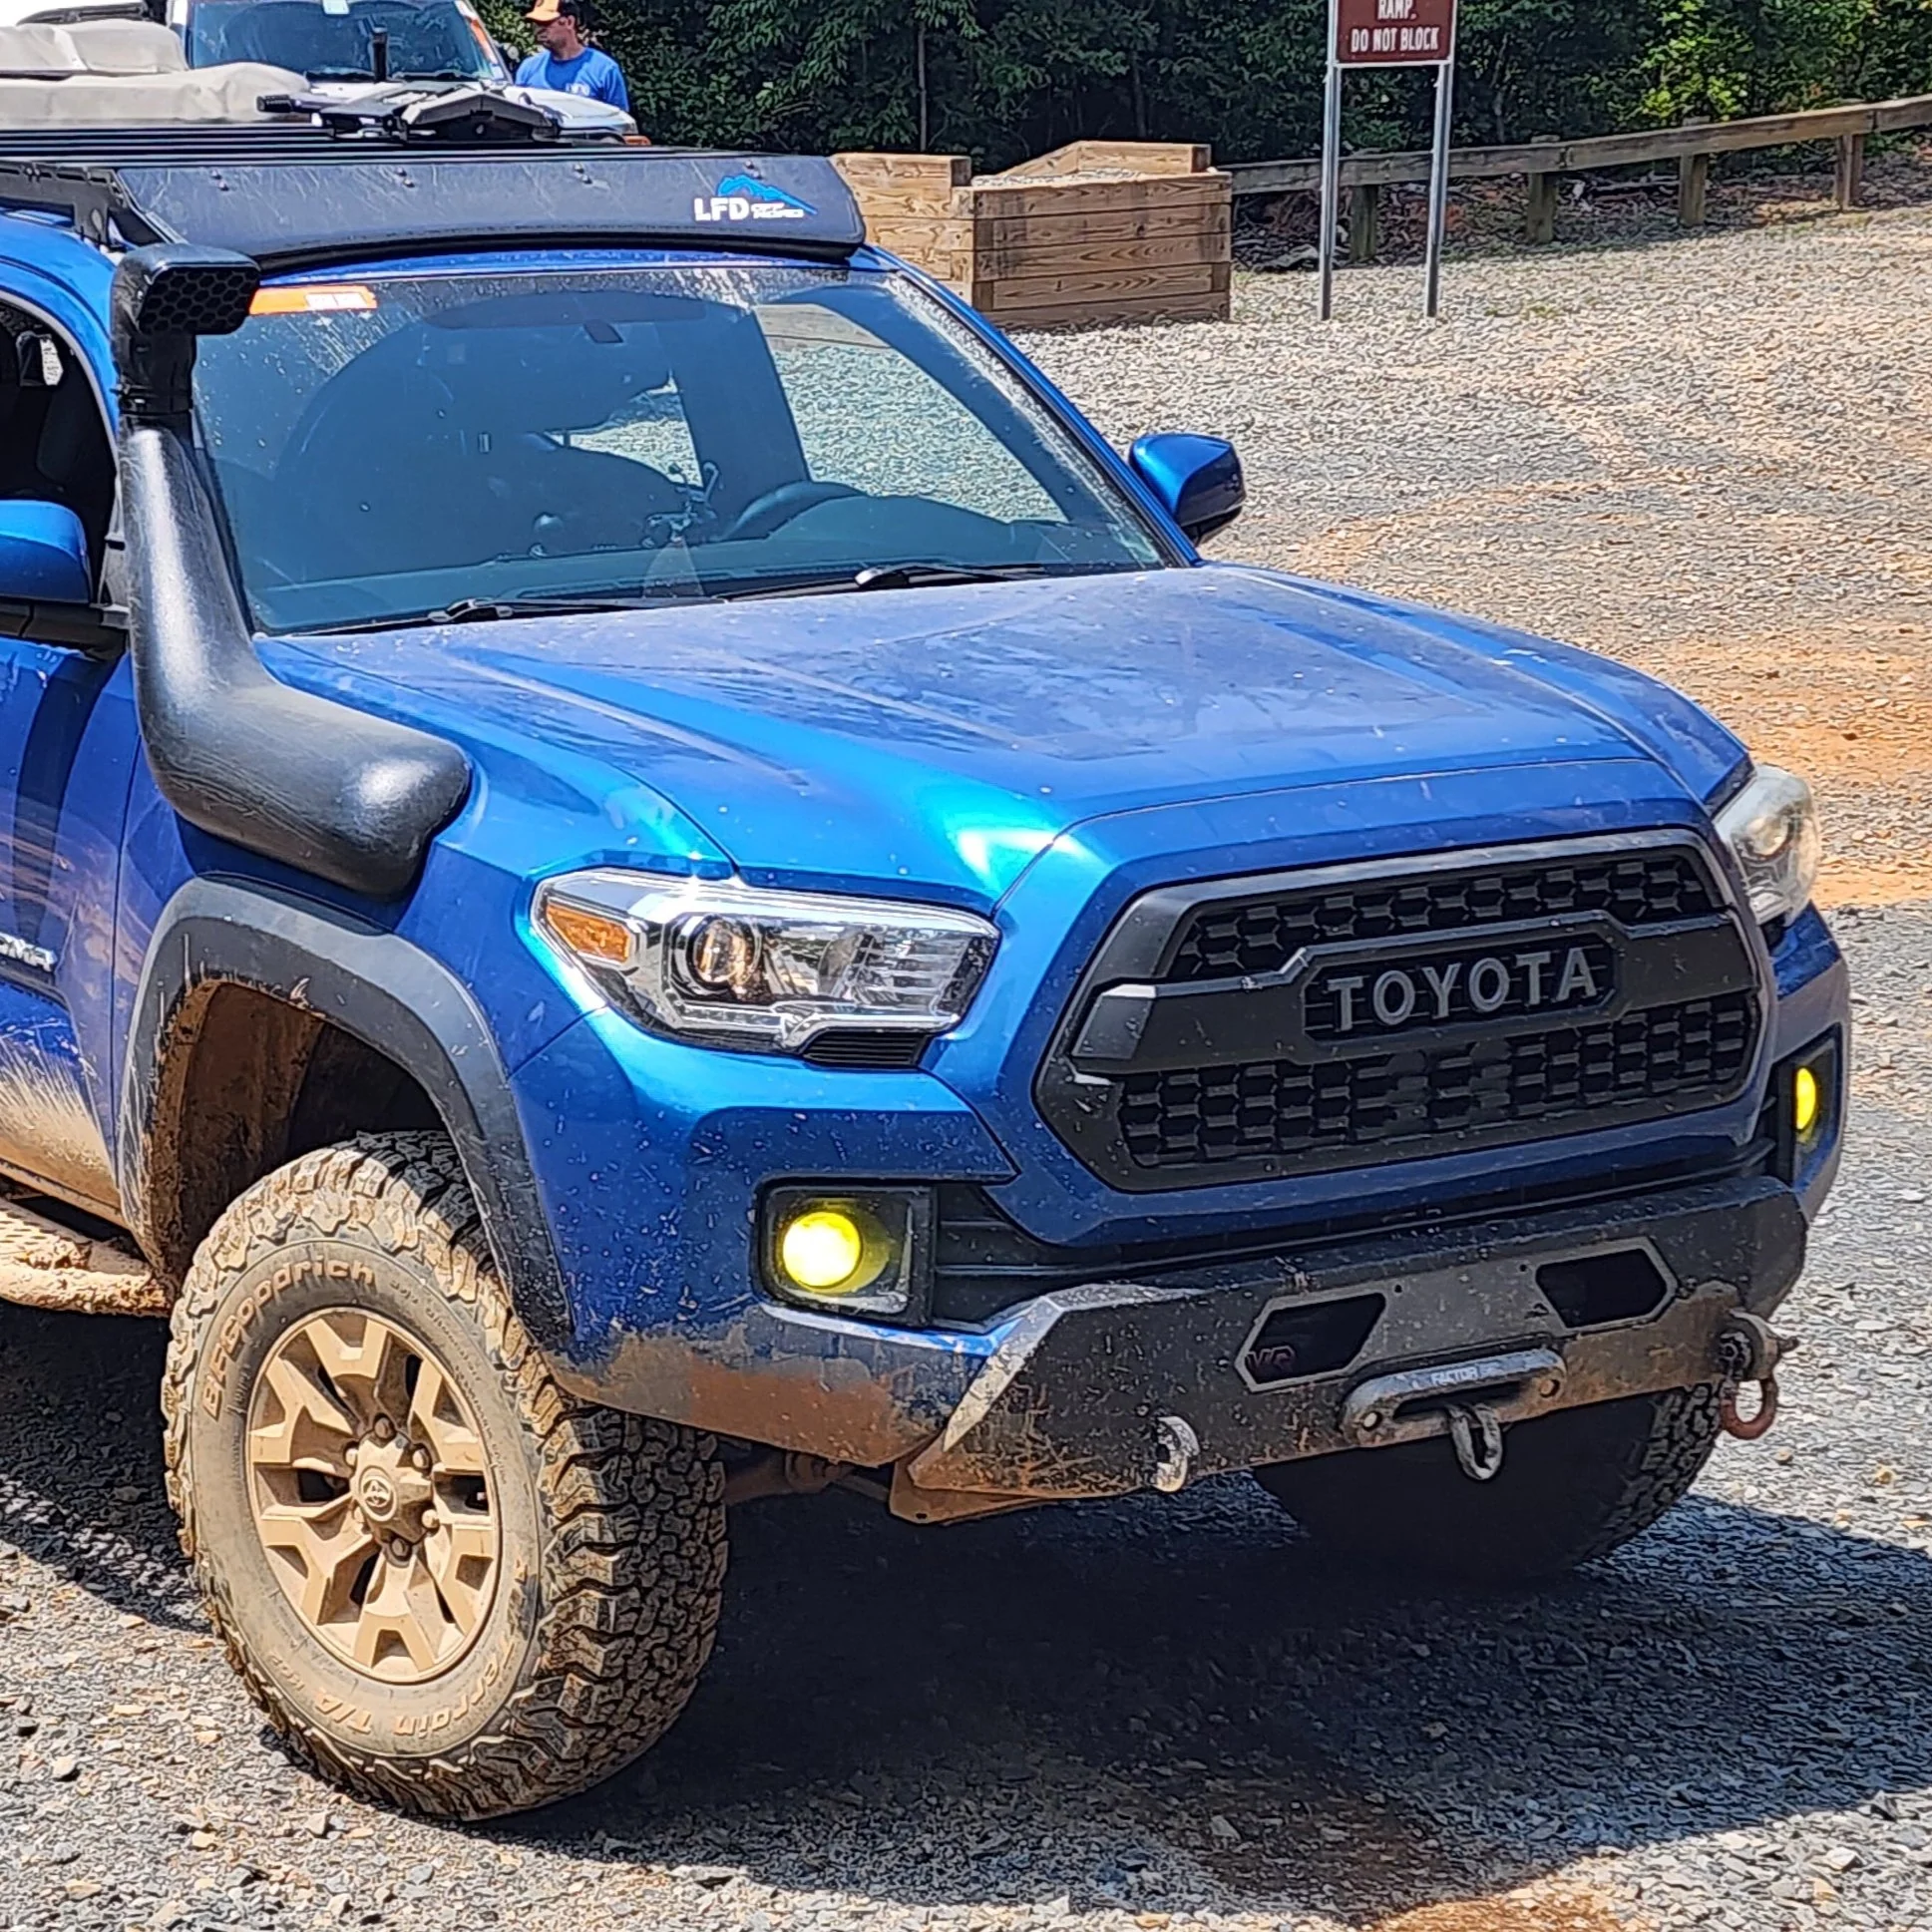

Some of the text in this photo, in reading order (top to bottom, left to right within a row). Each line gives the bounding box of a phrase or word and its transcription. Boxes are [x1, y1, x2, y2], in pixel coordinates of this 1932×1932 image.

[1351, 27, 1440, 53] DO NOT BLOCK
[693, 196, 749, 221] LFD
[1325, 947, 1597, 1032] TOYOTA
[202, 1254, 375, 1421] BFGoodrich
